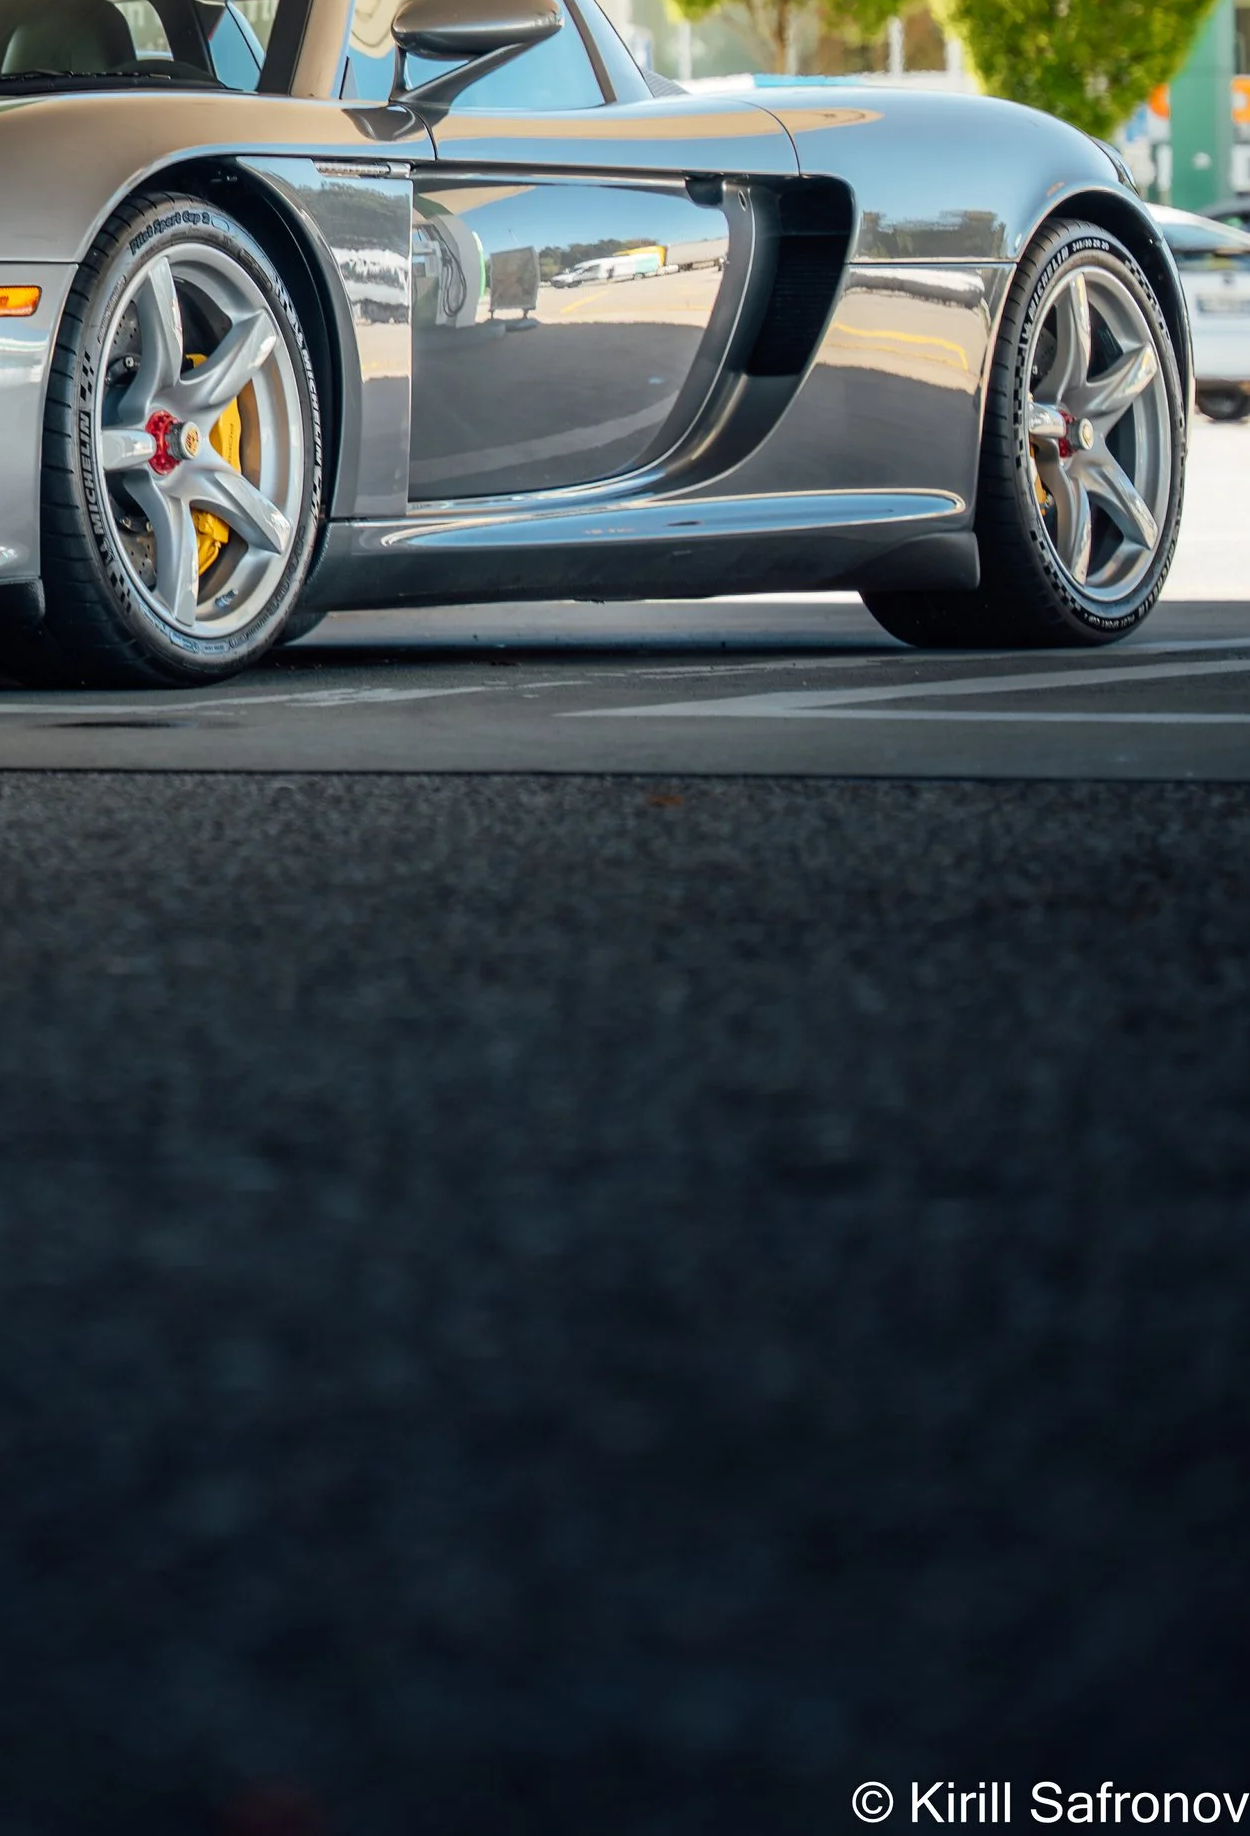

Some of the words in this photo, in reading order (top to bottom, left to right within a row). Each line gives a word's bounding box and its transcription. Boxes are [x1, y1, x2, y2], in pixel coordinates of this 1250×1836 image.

[129, 223, 155, 256] Pilot
[153, 211, 181, 234] Sport
[182, 210, 201, 226] Cup
[202, 211, 211, 225] 2
[1028, 247, 1069, 320] MICHELIN
[301, 348, 323, 466] MICHELIN
[79, 412, 105, 536] MICHELIN
